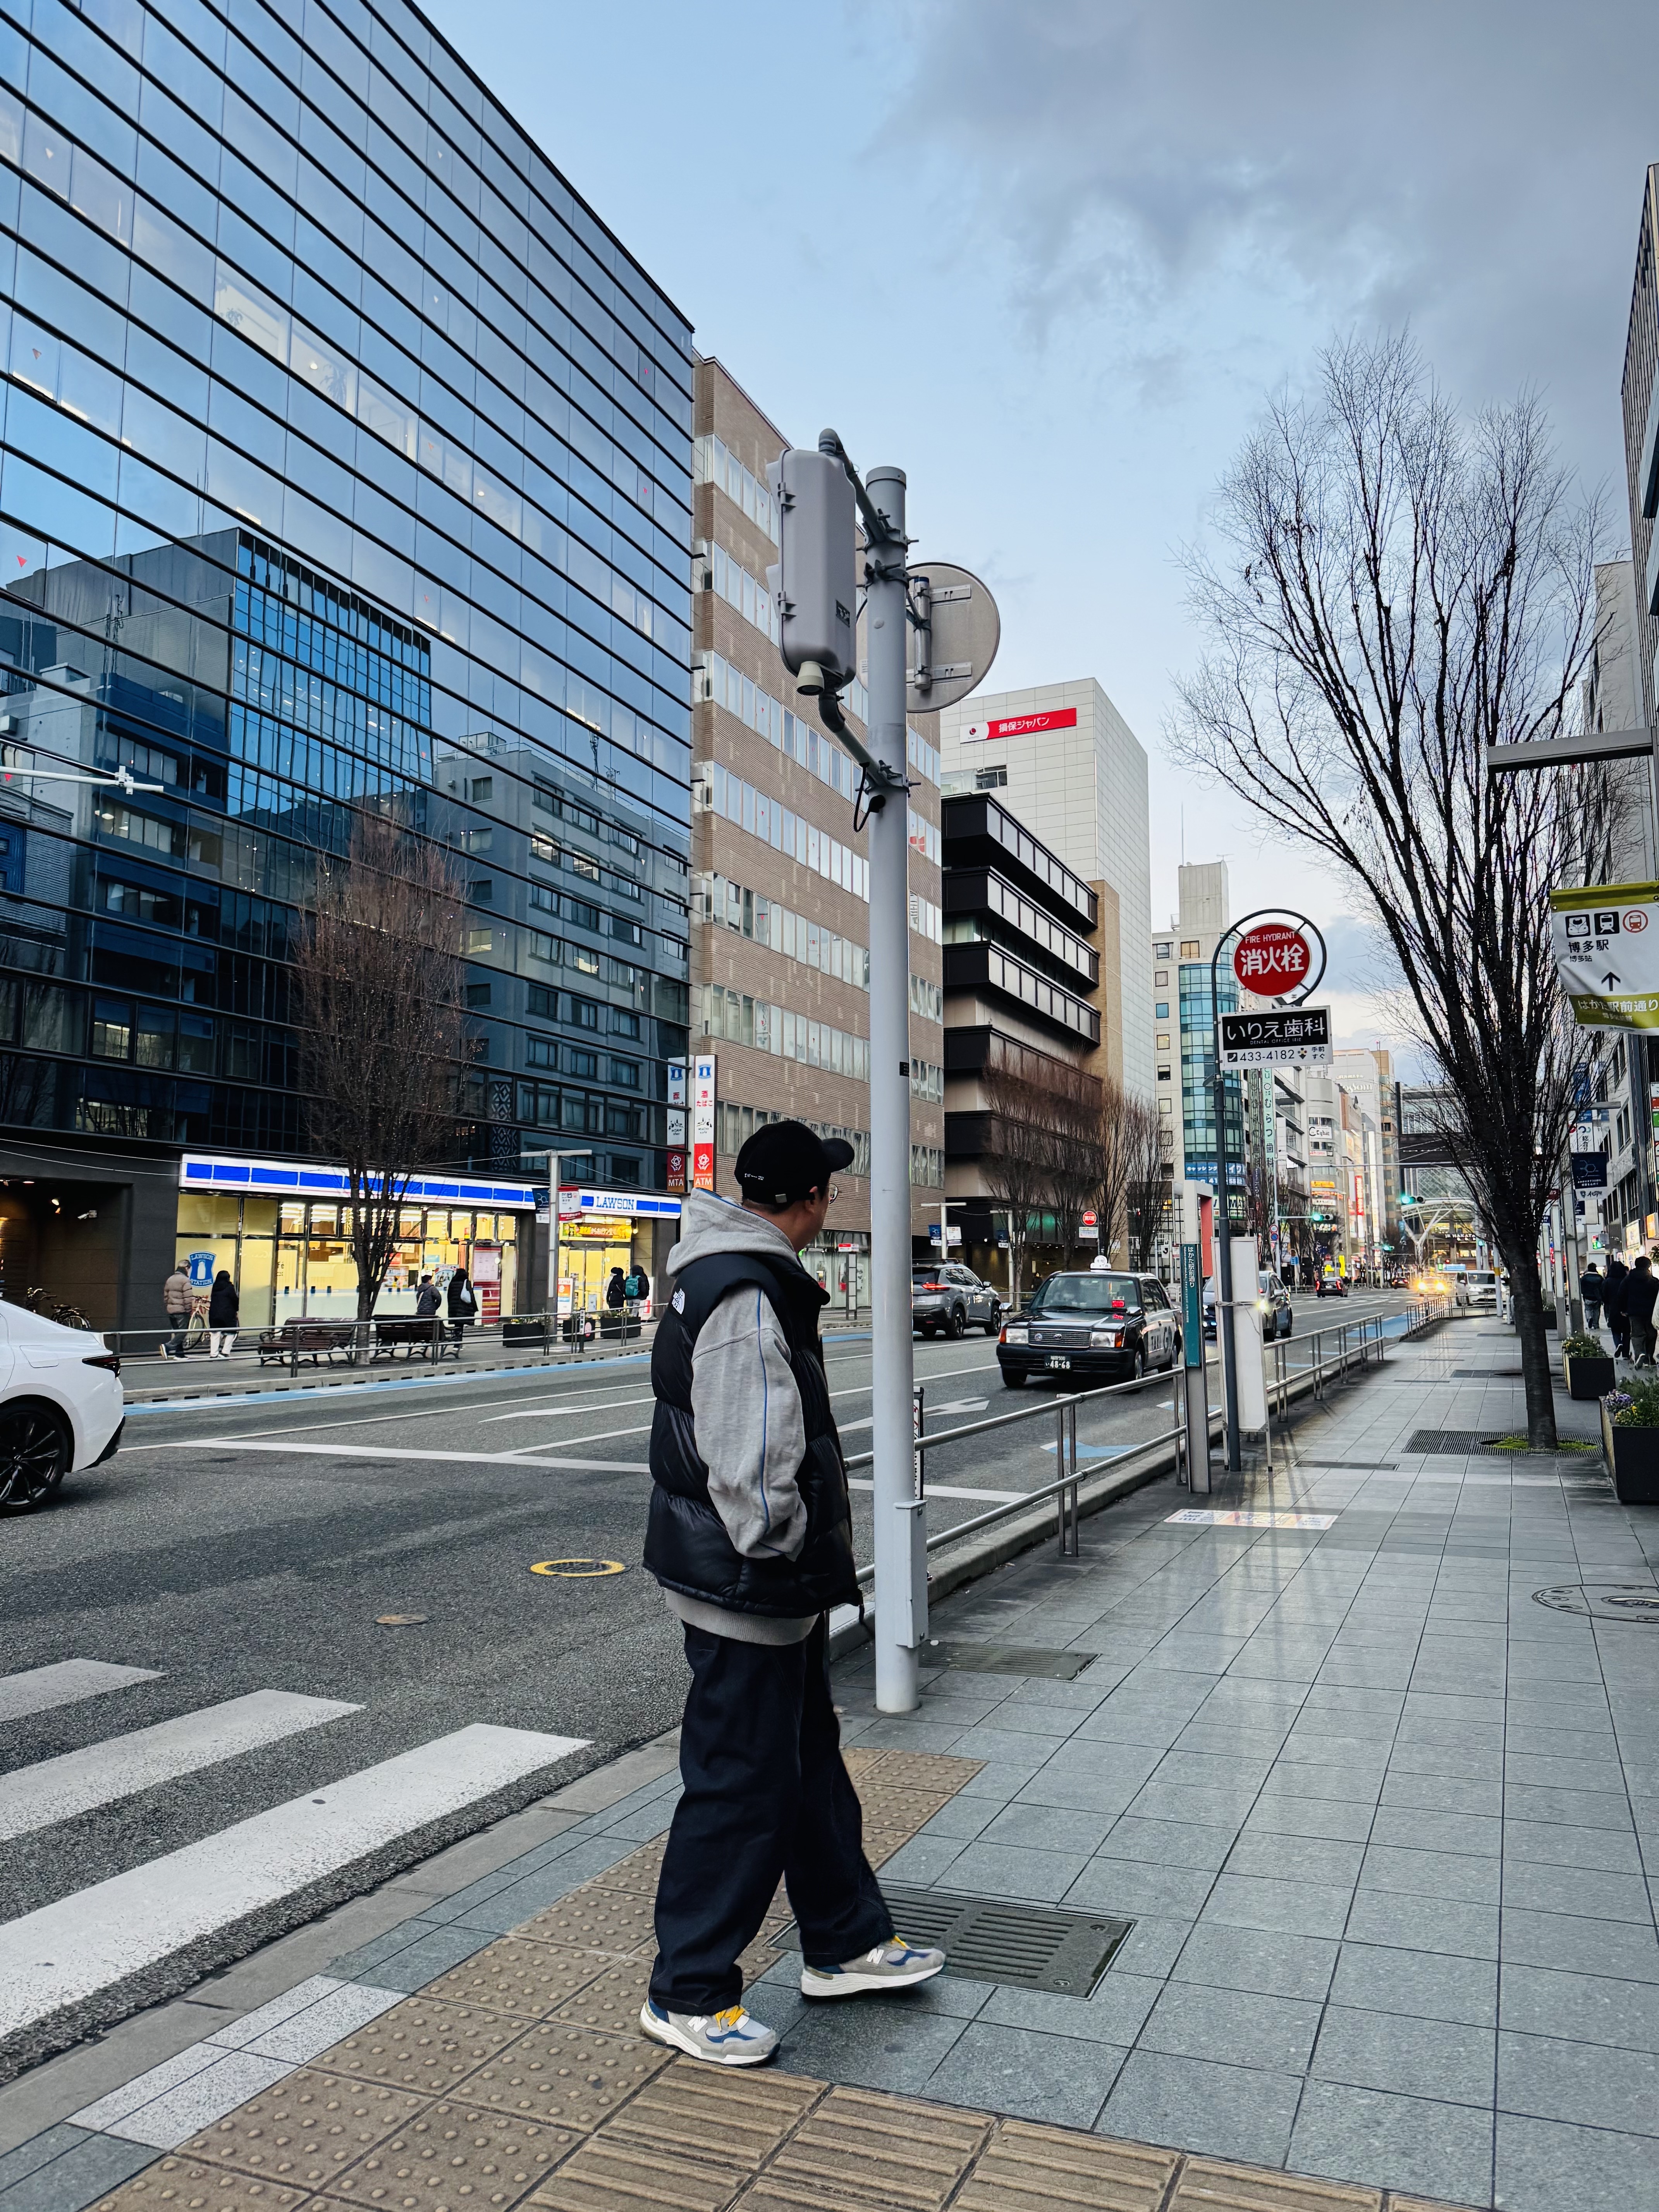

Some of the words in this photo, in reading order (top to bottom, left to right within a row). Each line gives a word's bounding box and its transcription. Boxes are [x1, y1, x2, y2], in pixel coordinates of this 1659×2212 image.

[999, 717, 1049, 733] 損保ジャパン
[1245, 935, 1260, 944] FIRE
[1263, 931, 1295, 942] HYDRANT
[1568, 939, 1609, 953] 博多駅
[1240, 943, 1304, 976] 消火栓
[1227, 1017, 1325, 1040] いりえ歯科
[1240, 1049, 1295, 1062] 433-4182
[695, 1177, 712, 1185] ATM
[596, 1196, 634, 1210] LAWSON
